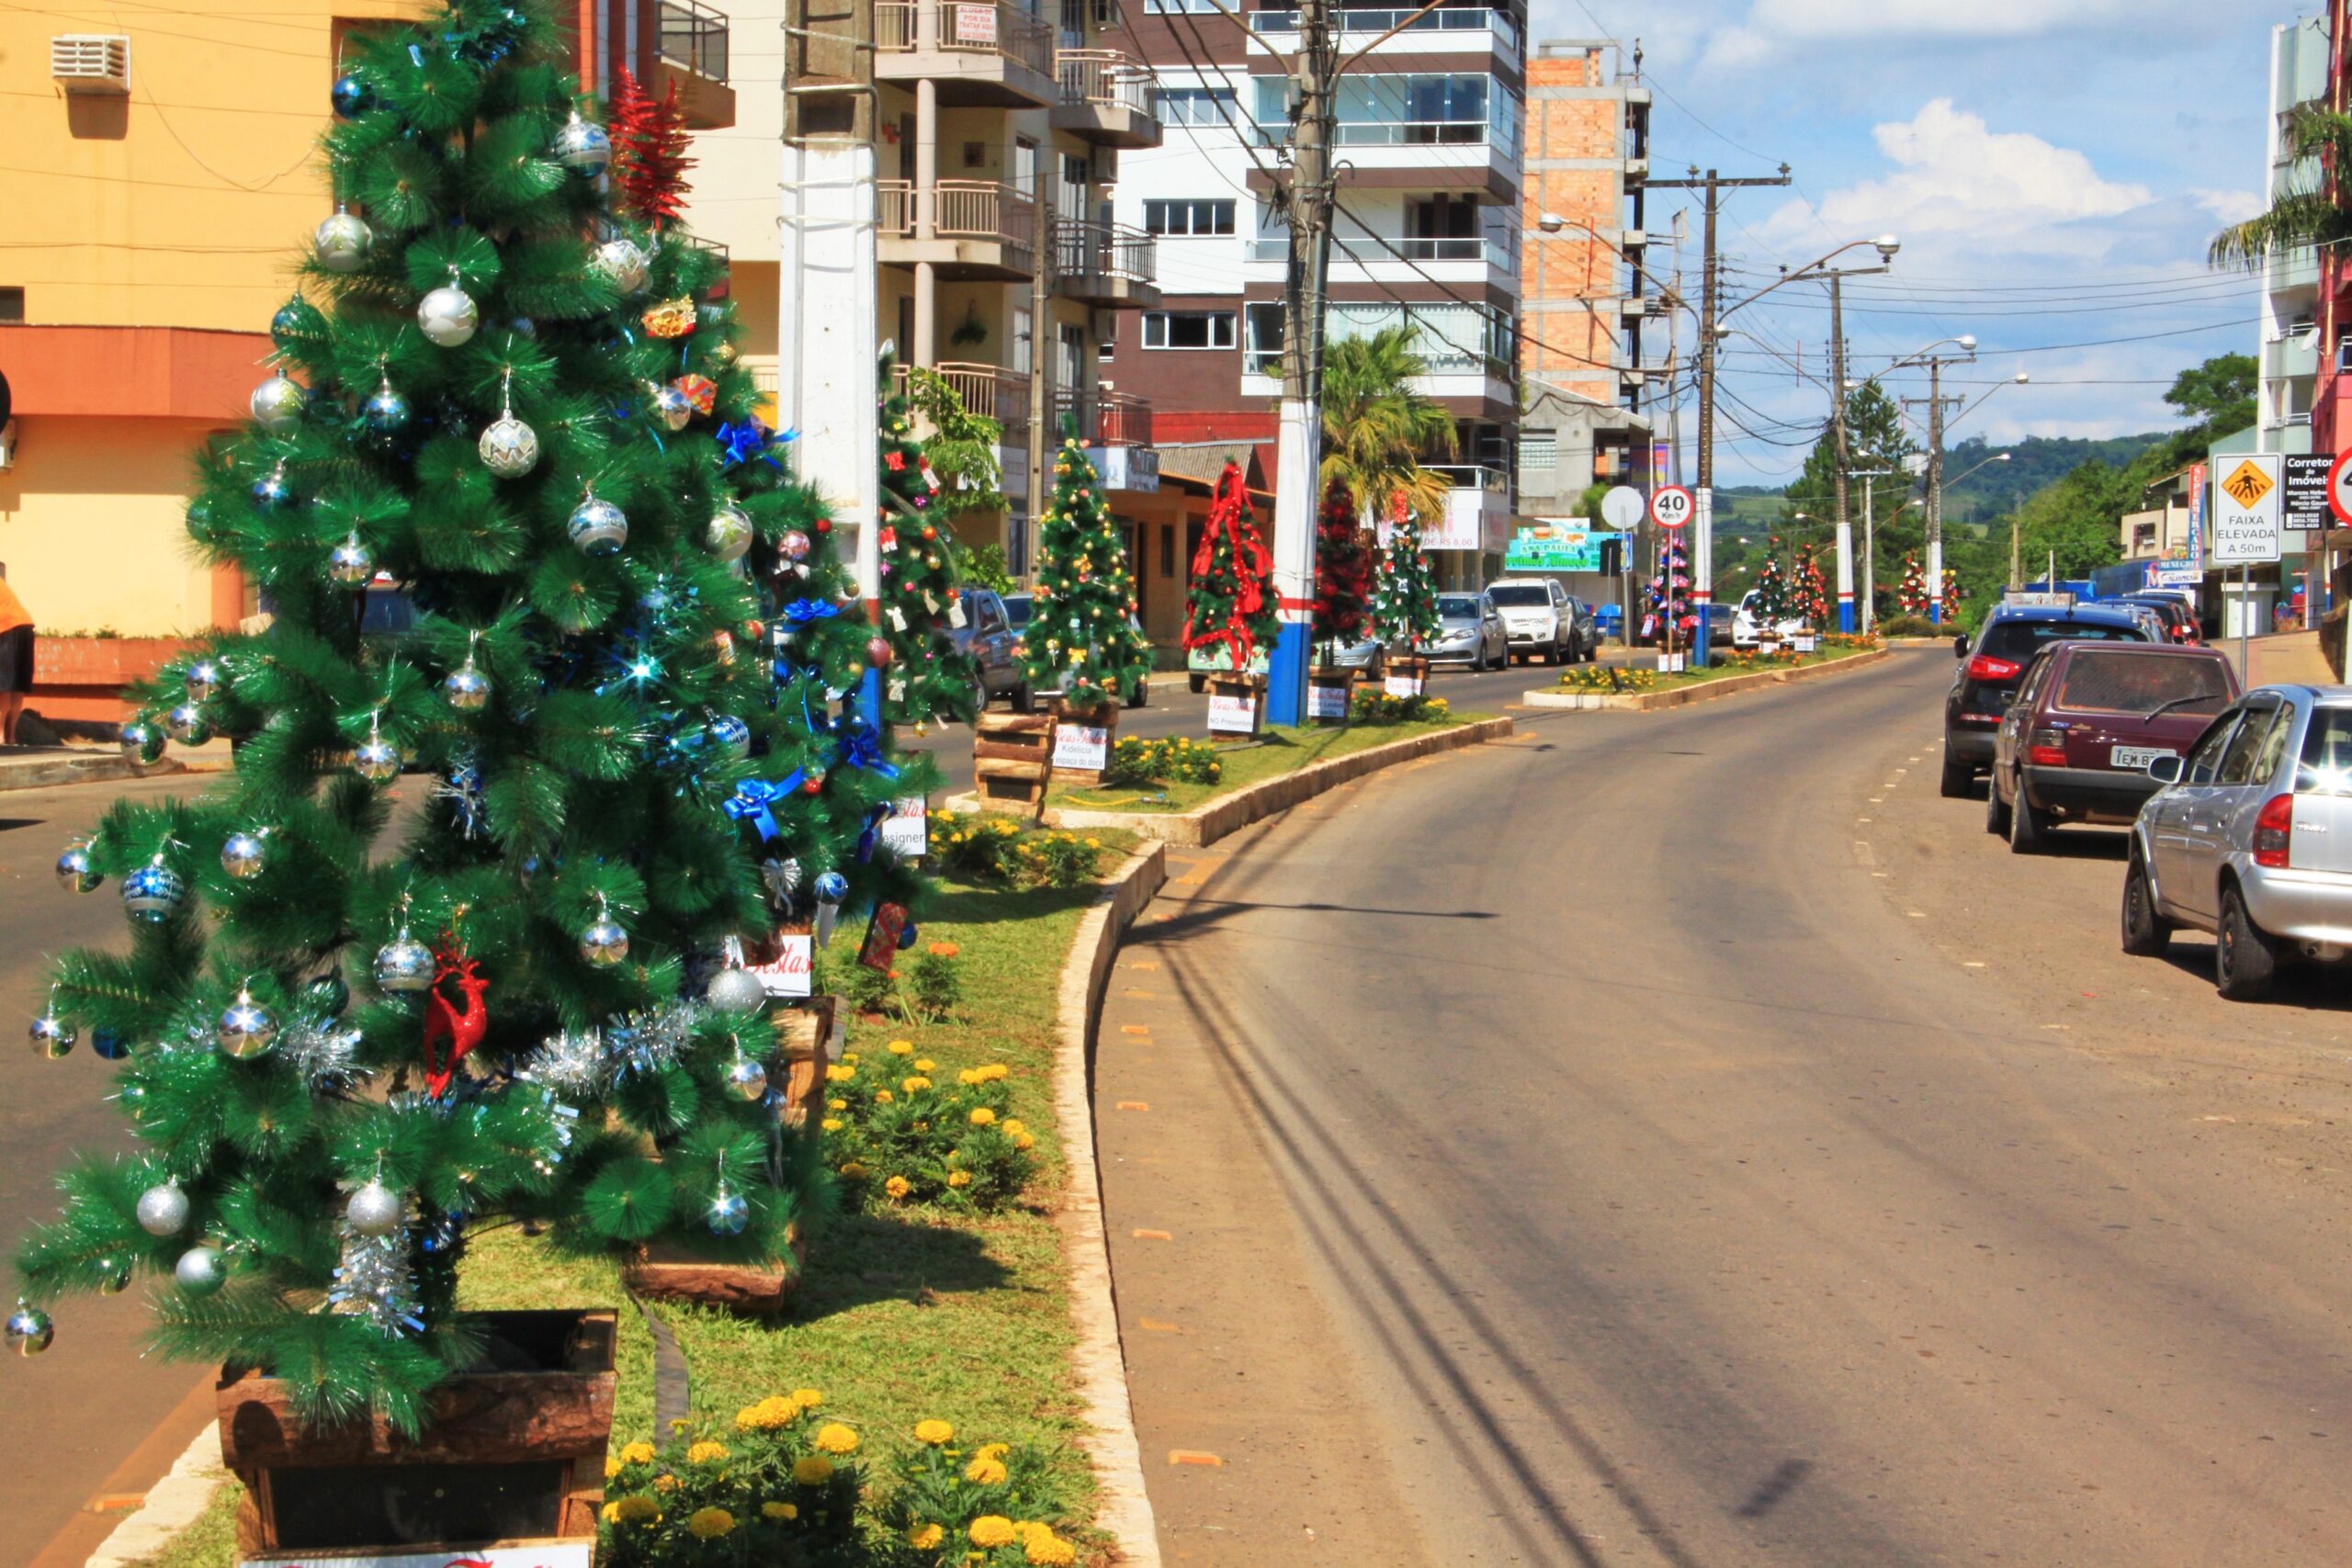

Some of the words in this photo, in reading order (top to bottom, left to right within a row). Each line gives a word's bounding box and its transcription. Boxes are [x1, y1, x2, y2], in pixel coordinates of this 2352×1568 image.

[2287, 458, 2335, 468] Corretor
[1657, 495, 1685, 511] 40
[2228, 515, 2265, 525] FAIXA
[2217, 529, 2277, 539] ELEVADA
[2227, 544, 2236, 554] A
[2239, 543, 2267, 553] 50m
